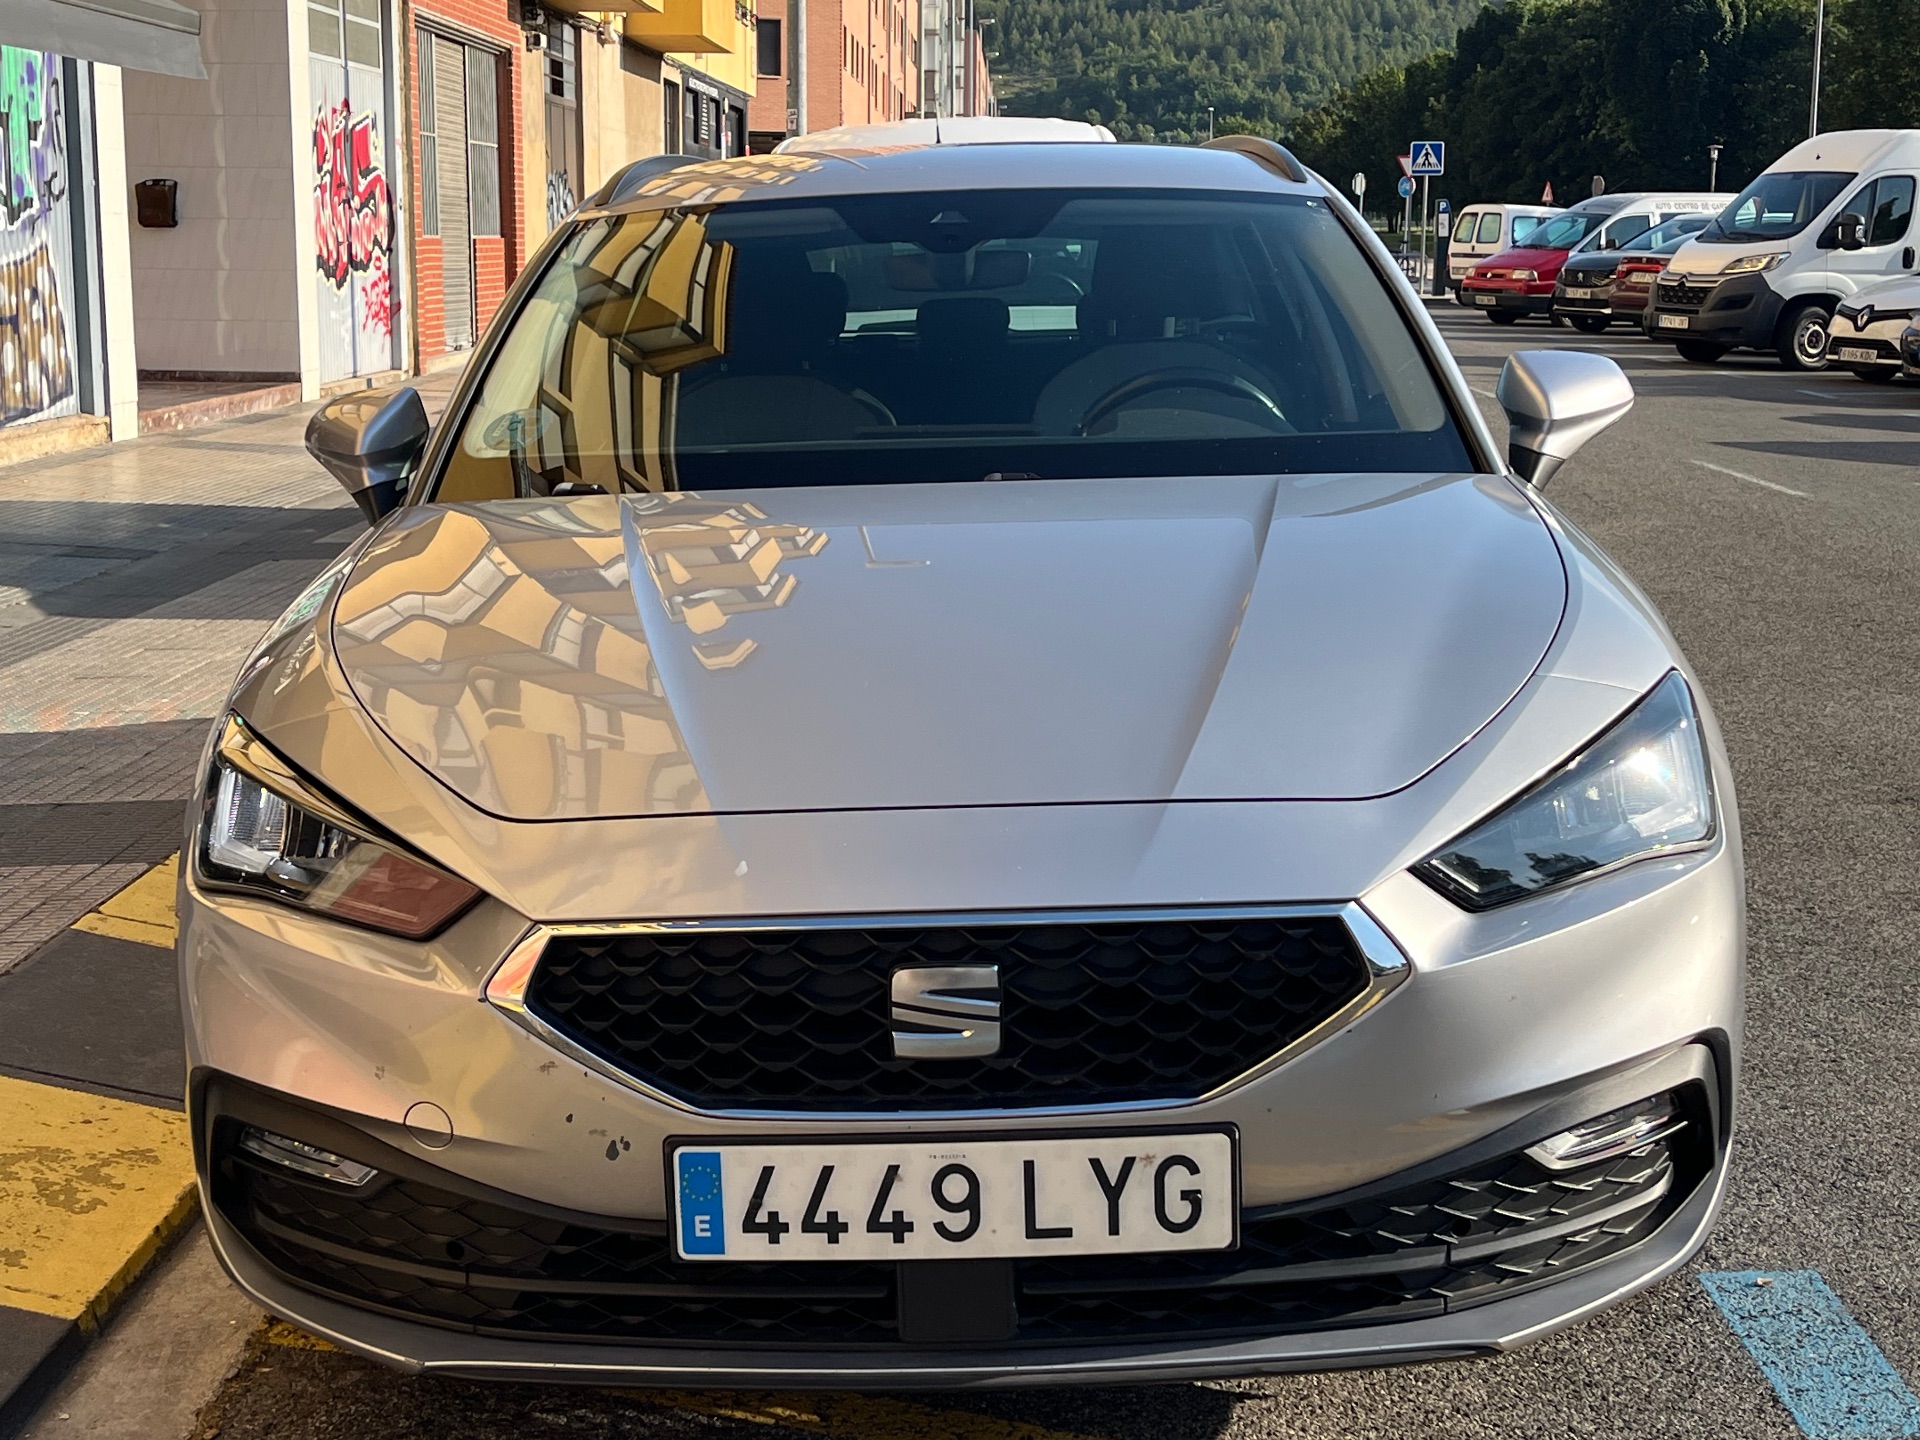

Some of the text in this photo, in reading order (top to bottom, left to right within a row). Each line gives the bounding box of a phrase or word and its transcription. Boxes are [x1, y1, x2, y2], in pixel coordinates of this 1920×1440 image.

[1440, 202, 1446, 211] P
[1656, 202, 1671, 210] AUTO
[1674, 202, 1699, 210] CENTRO
[1701, 202, 1710, 210] DE
[742, 1154, 1202, 1244] 4449 LYG
[694, 1215, 711, 1237] E
